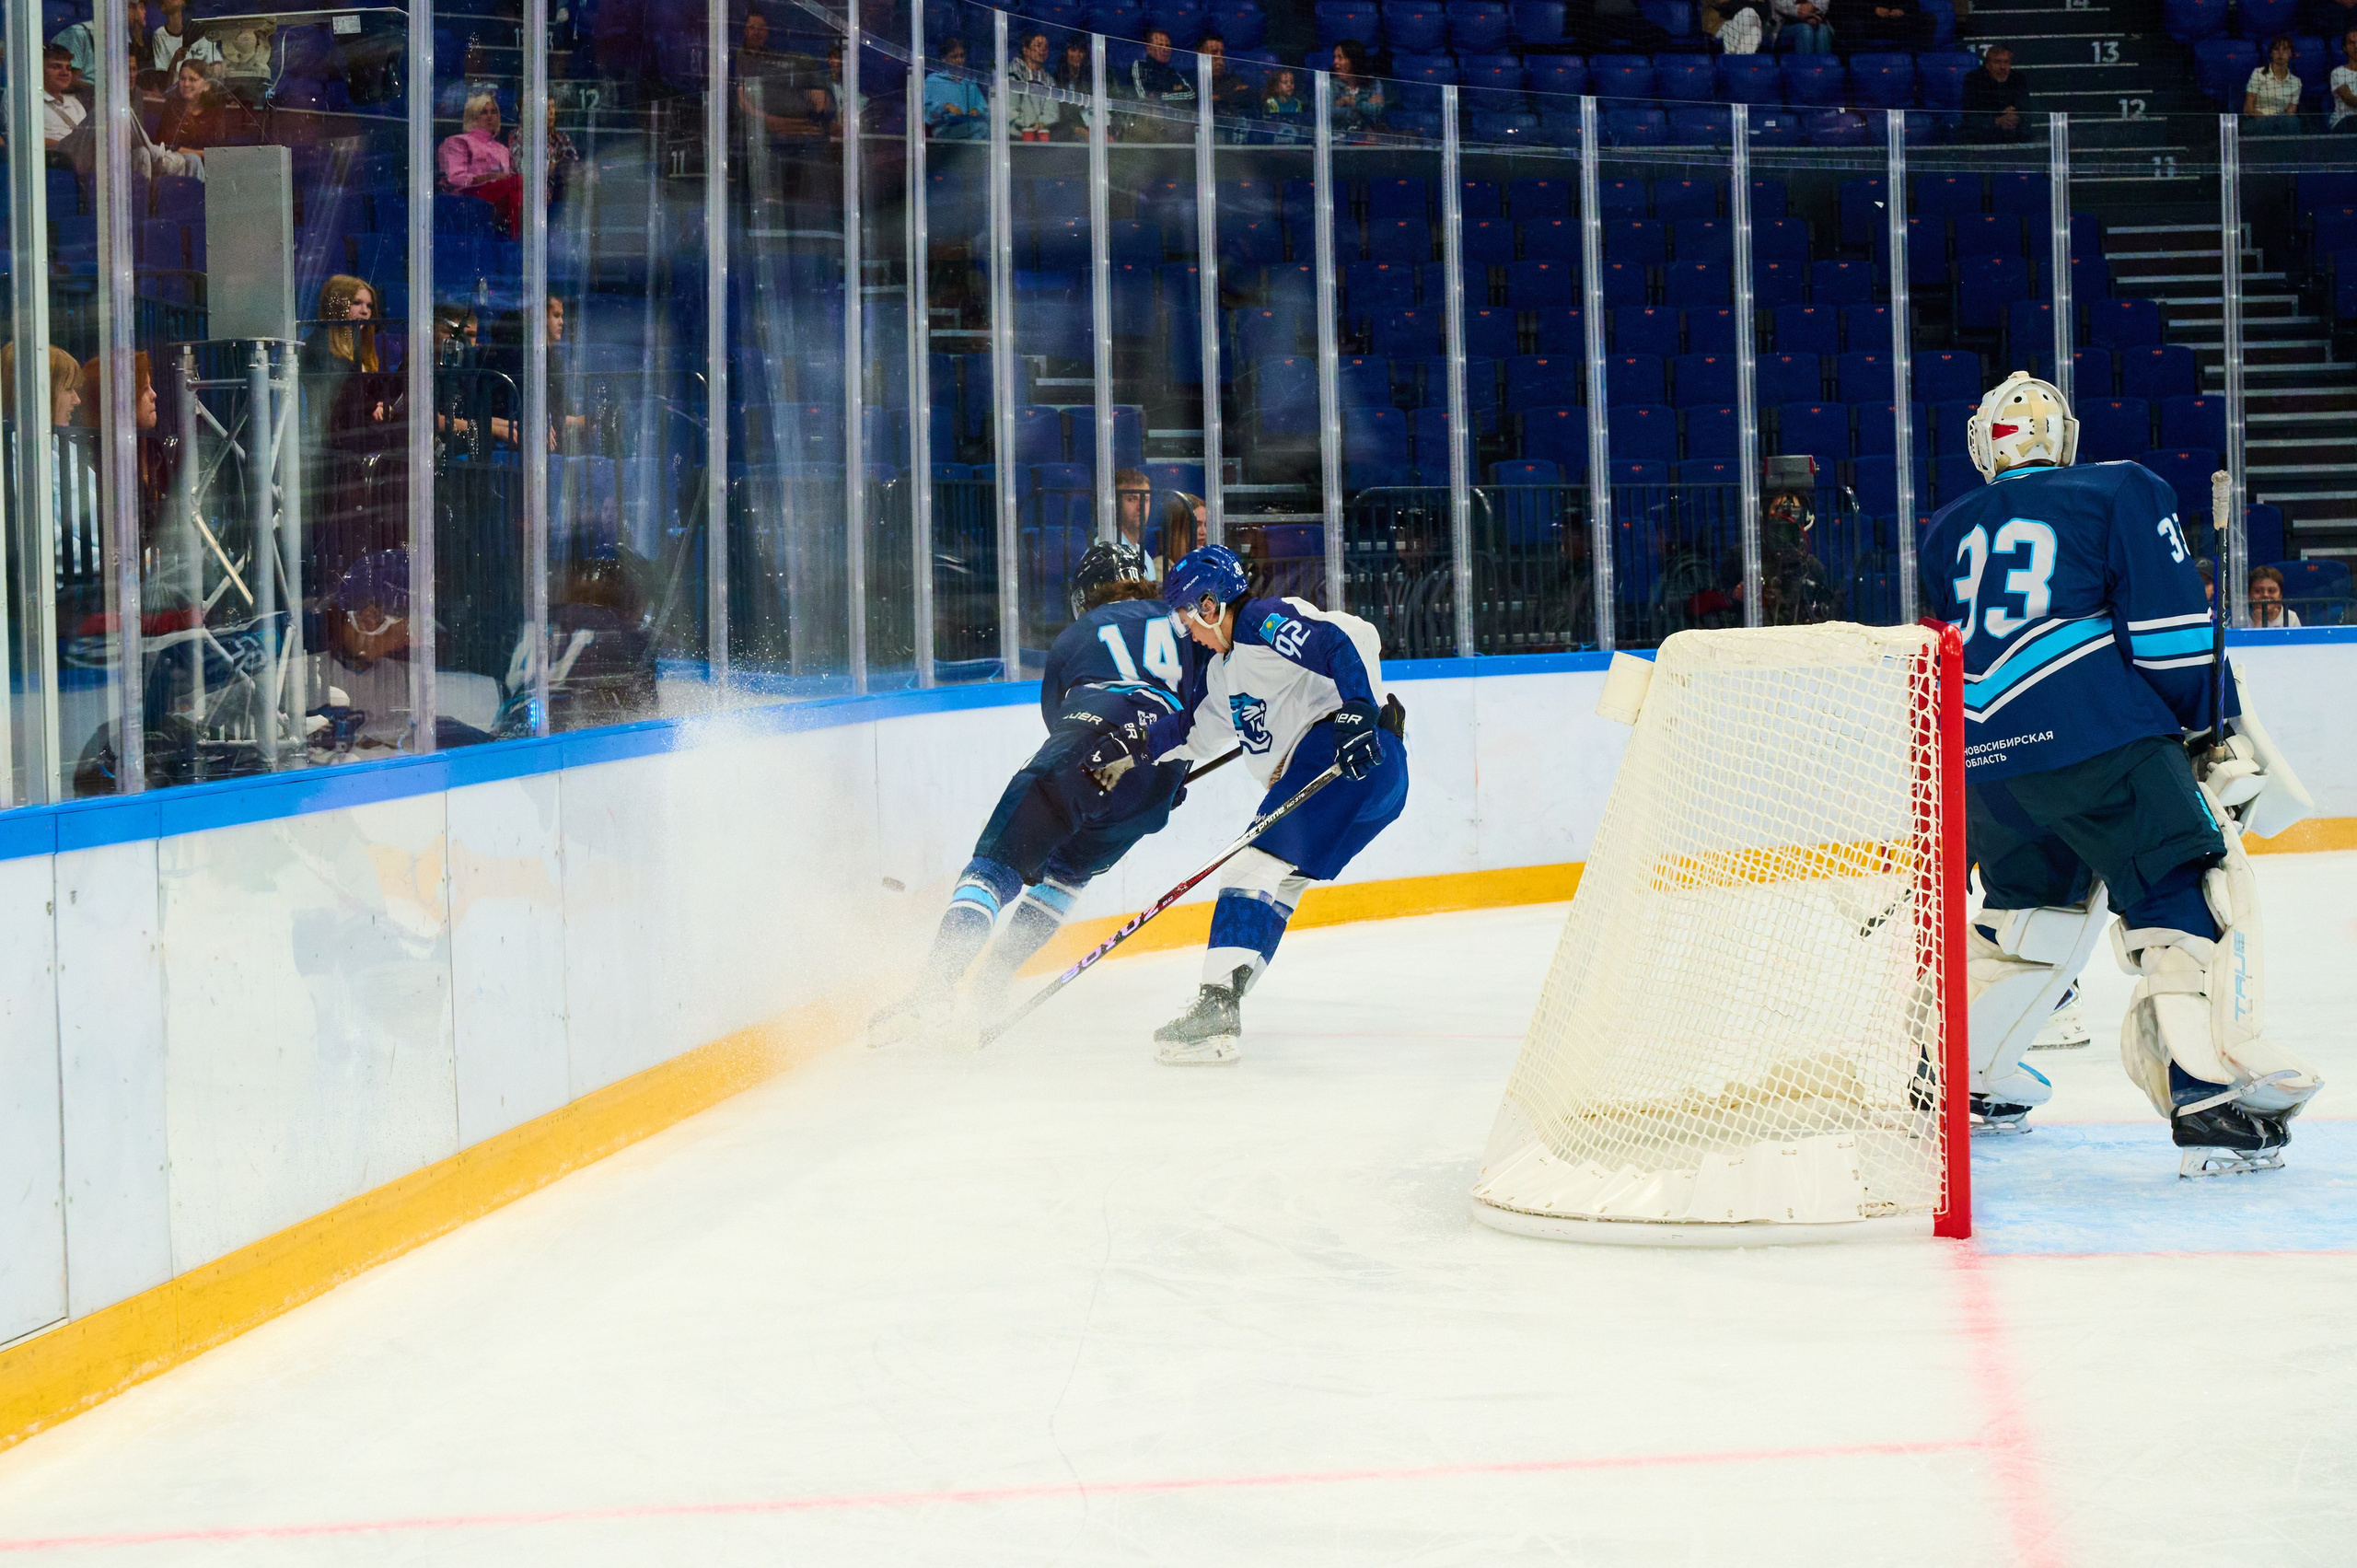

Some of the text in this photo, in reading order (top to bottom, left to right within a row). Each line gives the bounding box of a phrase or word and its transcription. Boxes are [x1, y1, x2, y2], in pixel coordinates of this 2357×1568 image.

[2091, 41, 2120, 64] 13
[578, 88, 600, 110] 12
[2119, 99, 2148, 120] 12
[670, 149, 686, 175] 11
[2153, 156, 2175, 178] 11
[1949, 517, 2058, 645] 33
[1275, 620, 1311, 659] 92
[1097, 616, 1183, 691] 14
[1964, 730, 2054, 756] НОВОСИБИРСКАЯ
[1965, 752, 2007, 769] ОБЛАСТЬ
[1062, 901, 1159, 984] SOYUZ
[2233, 929, 2247, 1022] TRUE
